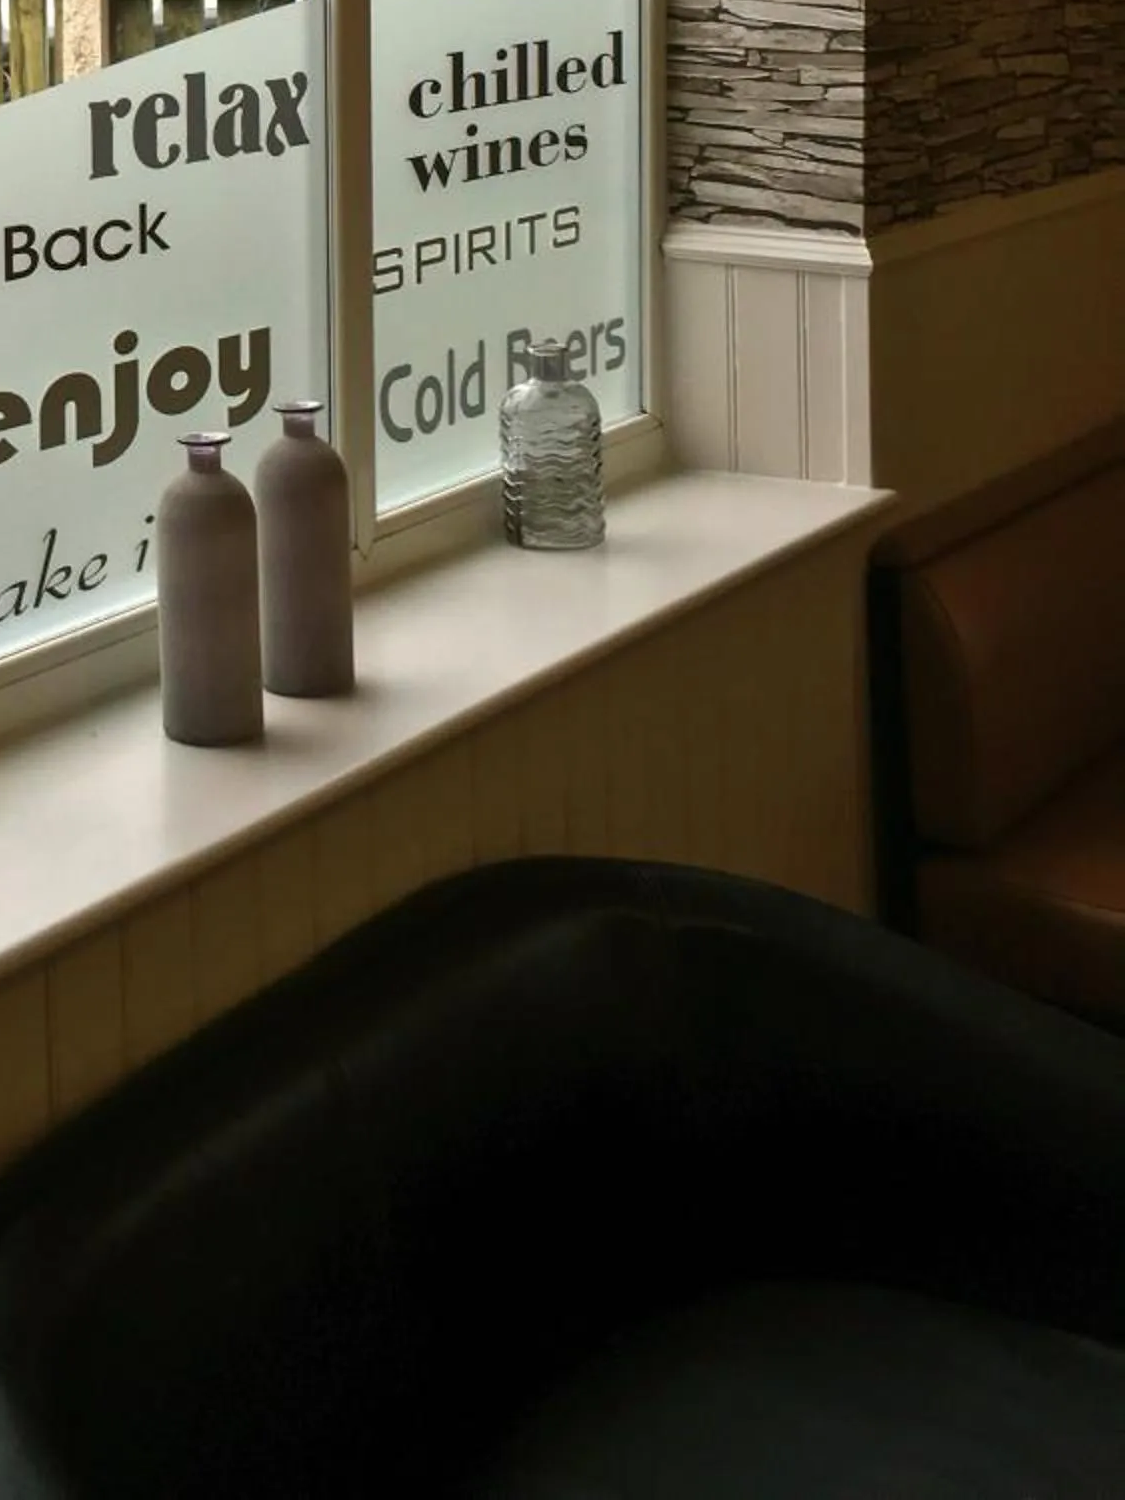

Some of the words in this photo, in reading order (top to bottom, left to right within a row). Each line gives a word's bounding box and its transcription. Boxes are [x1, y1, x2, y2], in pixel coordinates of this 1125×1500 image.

[408, 31, 626, 119] chilled
[89, 71, 311, 180] relax
[406, 123, 588, 193] wines
[5, 203, 170, 283] Back
[373, 205, 581, 295] SPIRITS
[380, 339, 486, 443] Cold
[507, 317, 626, 389] Bers
